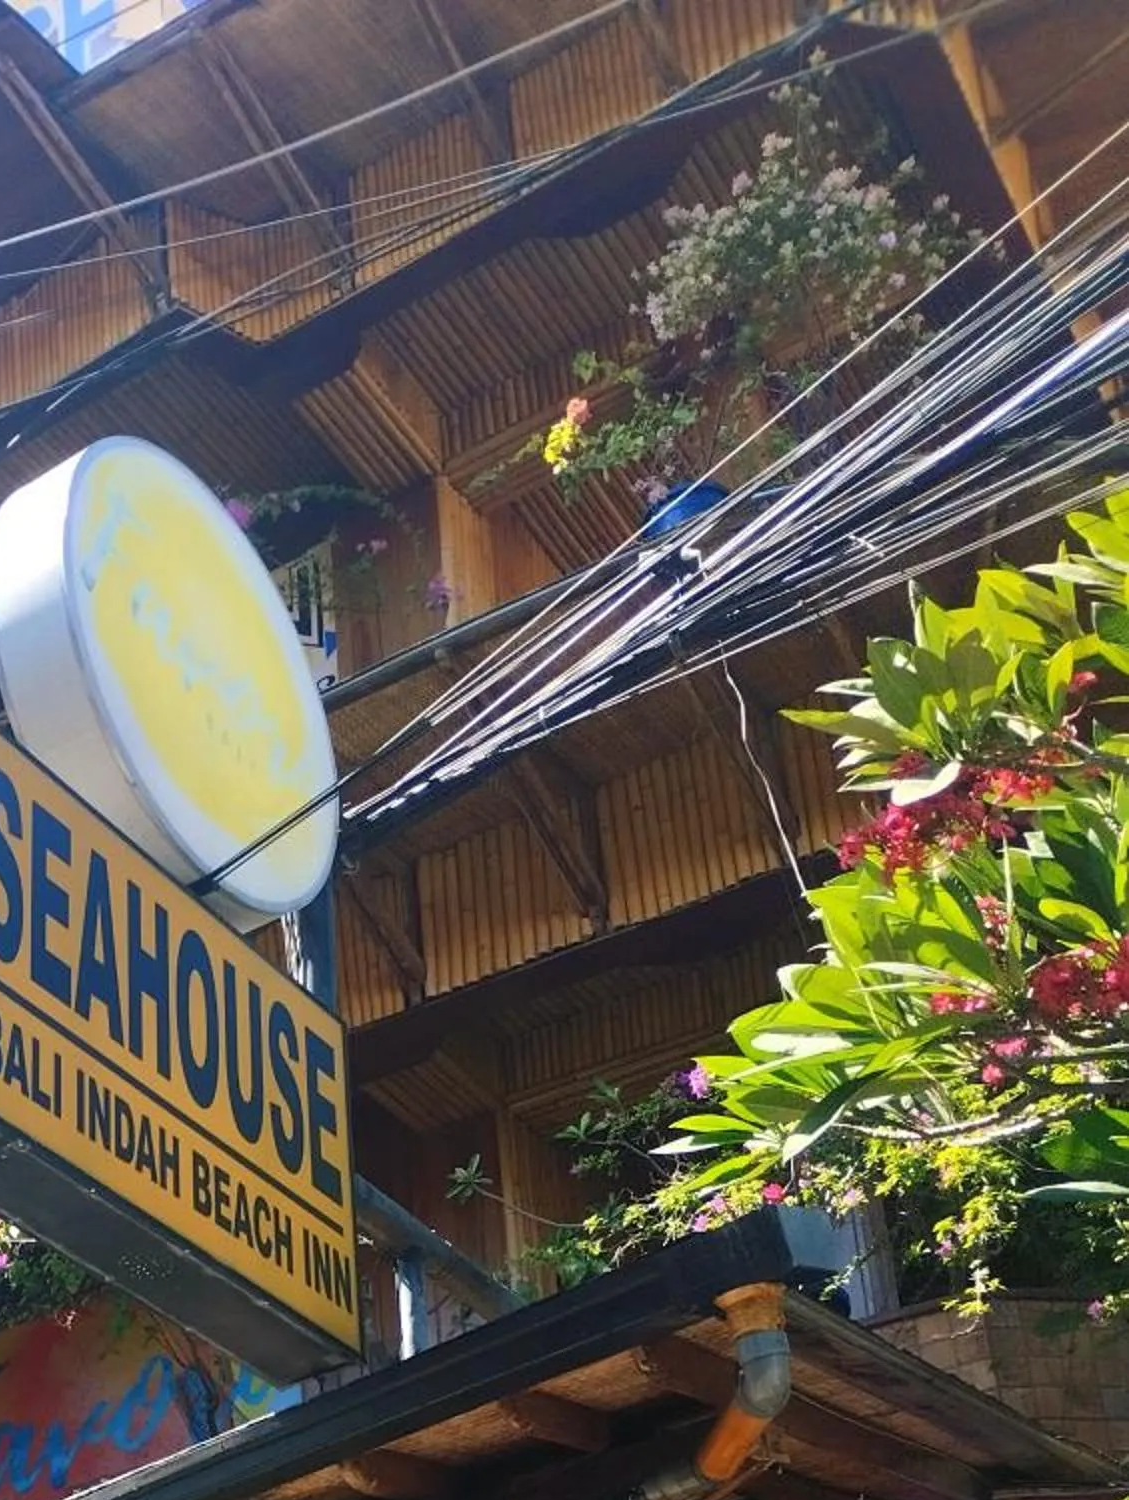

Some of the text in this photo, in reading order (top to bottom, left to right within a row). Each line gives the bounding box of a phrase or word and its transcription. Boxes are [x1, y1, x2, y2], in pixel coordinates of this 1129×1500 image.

[77, 1085, 181, 1202] INDAH
[191, 1159, 294, 1277] BEACH
[303, 1230, 354, 1314] INN
